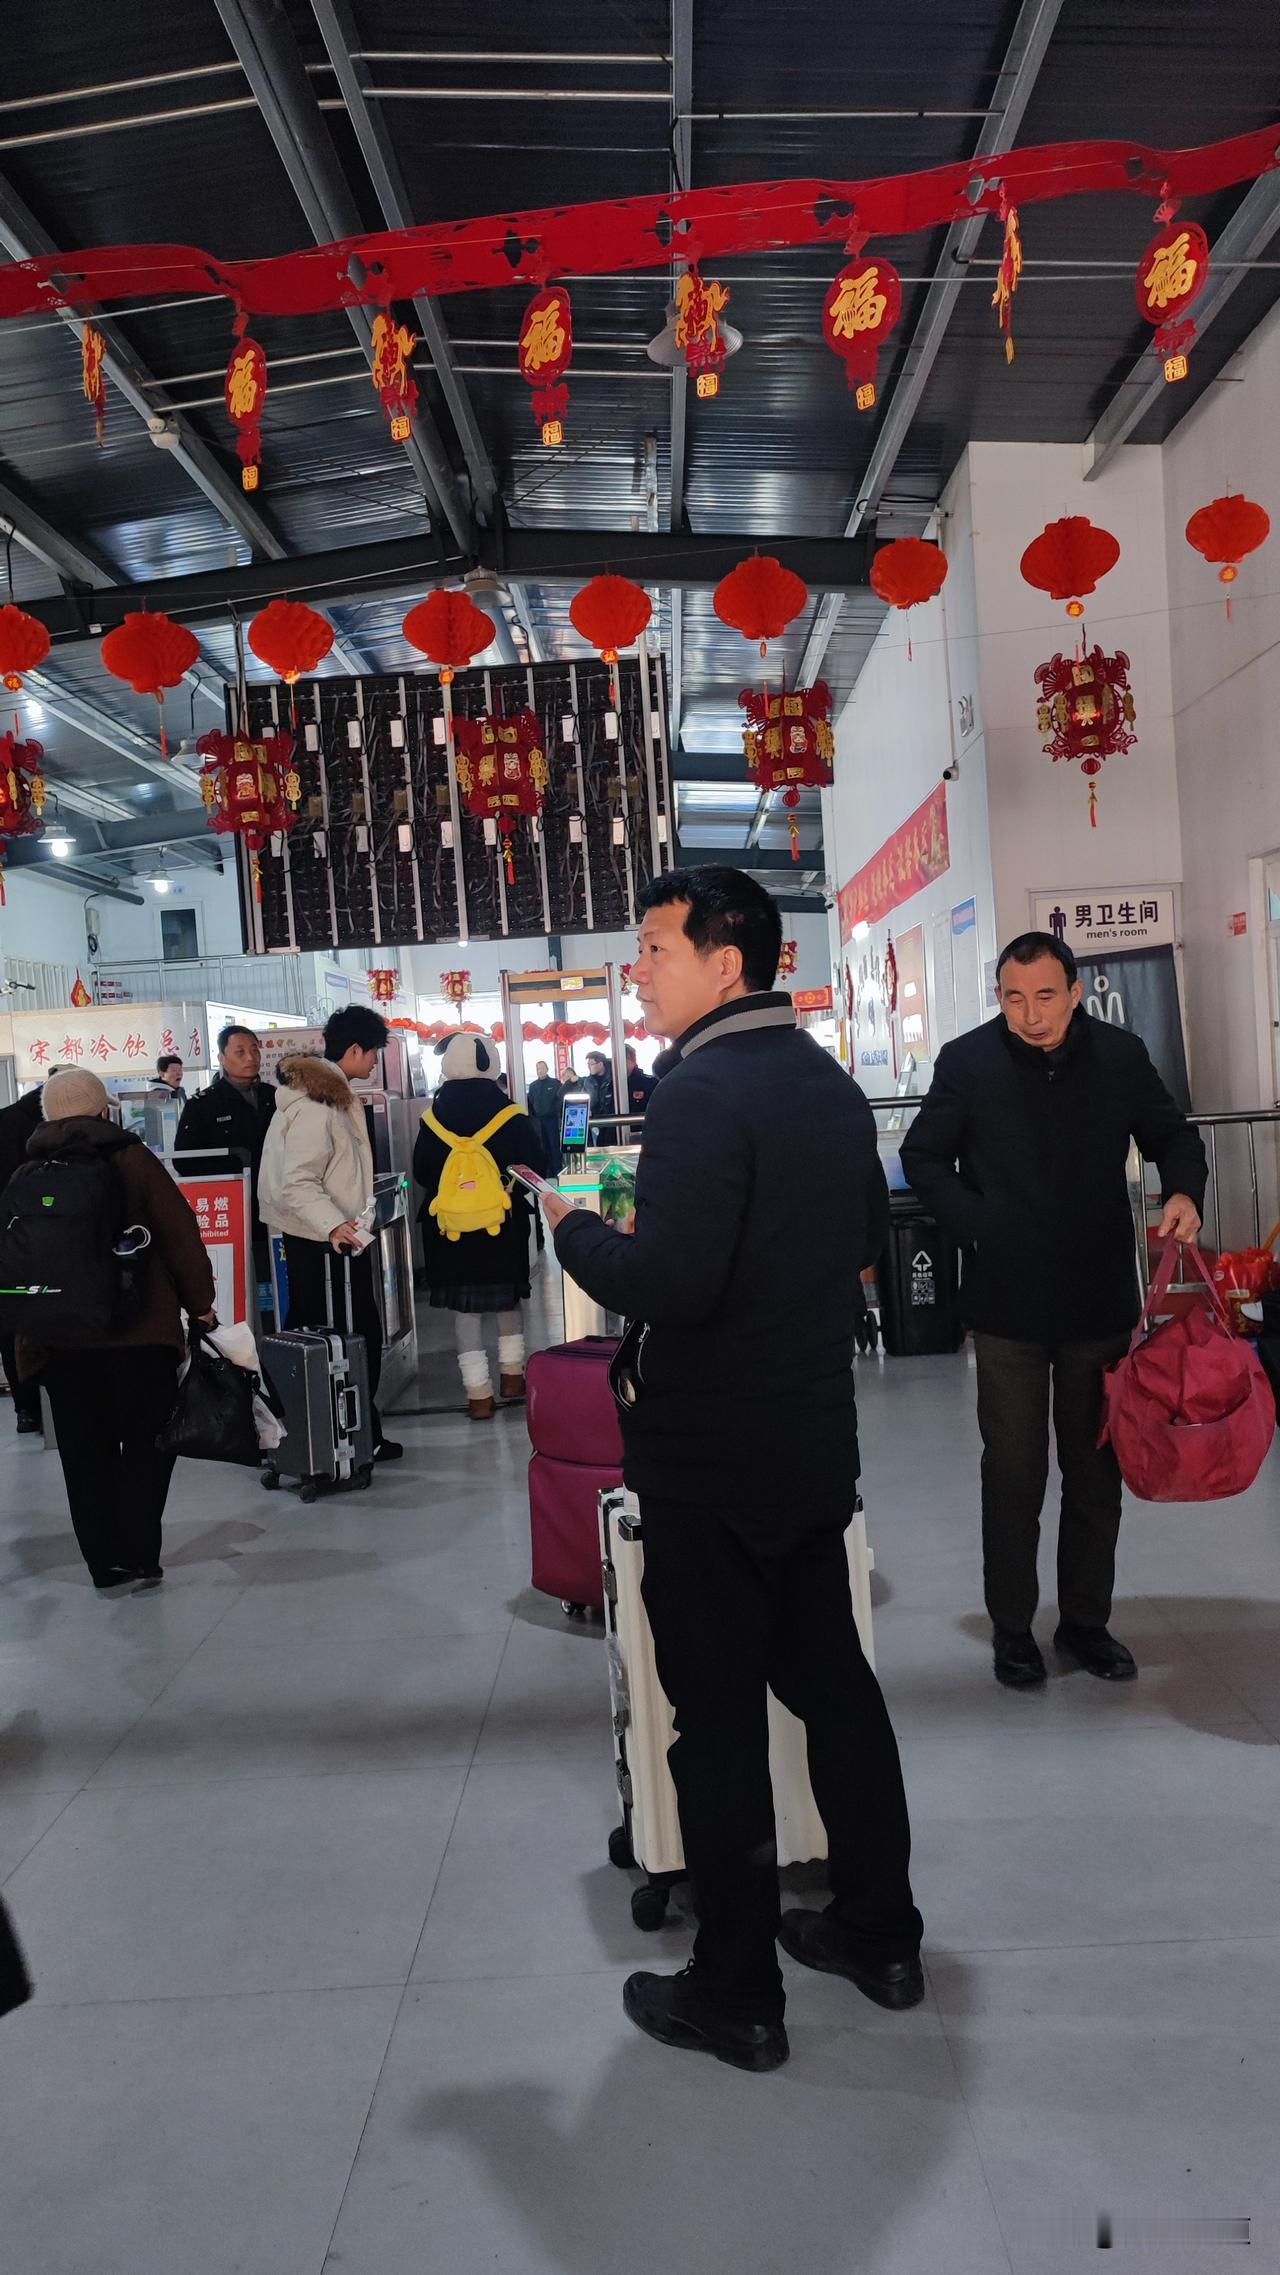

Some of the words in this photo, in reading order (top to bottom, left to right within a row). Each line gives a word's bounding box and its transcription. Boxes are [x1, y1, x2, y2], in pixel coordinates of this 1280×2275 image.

[1144, 232, 1197, 308] 福
[829, 266, 887, 339] 福
[521, 299, 565, 370] 福
[1165, 356, 1187, 382] 福
[229, 349, 257, 418] 福
[697, 373, 718, 397] 福
[856, 383, 876, 410] 福
[391, 416, 411, 441] 福
[542, 420, 563, 446] 福
[1075, 900, 1159, 928] 男卫生间
[1087, 929, 1117, 939] men's
[1119, 927, 1148, 937] room
[29, 1028, 201, 1065] 宋都冷饮总店
[187, 1197, 229, 1212] 易燃
